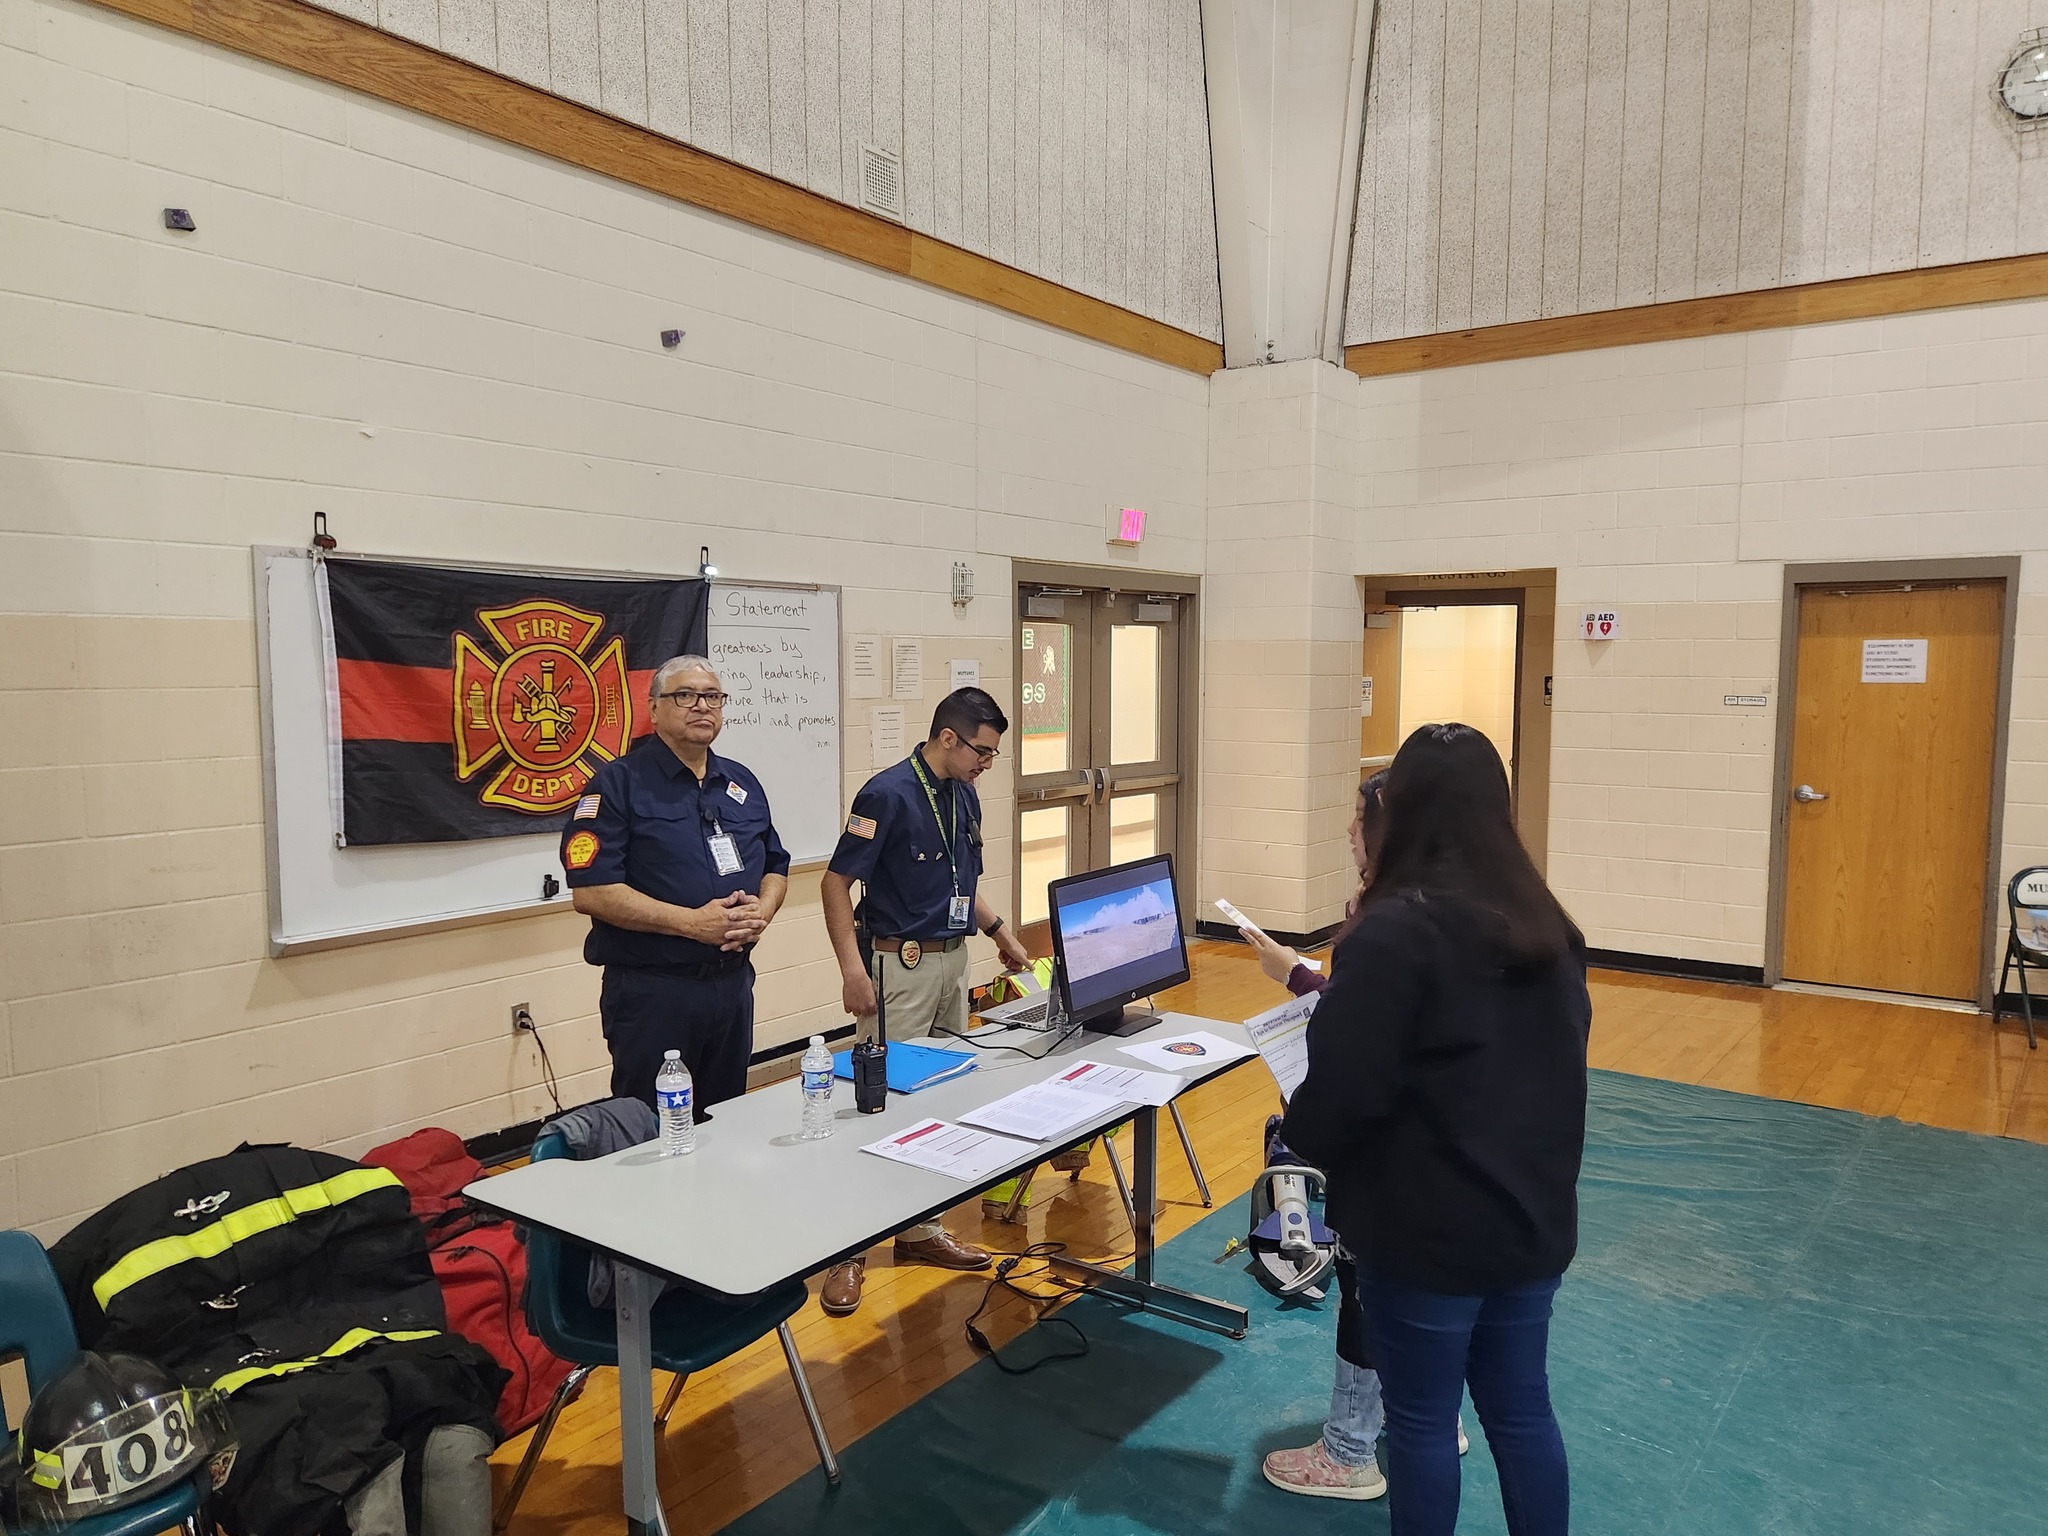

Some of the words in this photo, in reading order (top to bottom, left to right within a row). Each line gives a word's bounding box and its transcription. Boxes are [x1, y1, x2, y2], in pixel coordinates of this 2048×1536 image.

[725, 591, 808, 617] Statement
[515, 618, 573, 641] FIRE
[1597, 613, 1615, 622] AED
[712, 640, 773, 663] greatness
[780, 636, 803, 658] by
[759, 661, 828, 686] leadership,
[762, 688, 789, 706] that
[795, 693, 808, 704] is
[770, 714, 793, 729] and
[798, 714, 836, 732] promotes
[512, 772, 587, 797] DEPT.
[70, 1409, 188, 1497] 408
